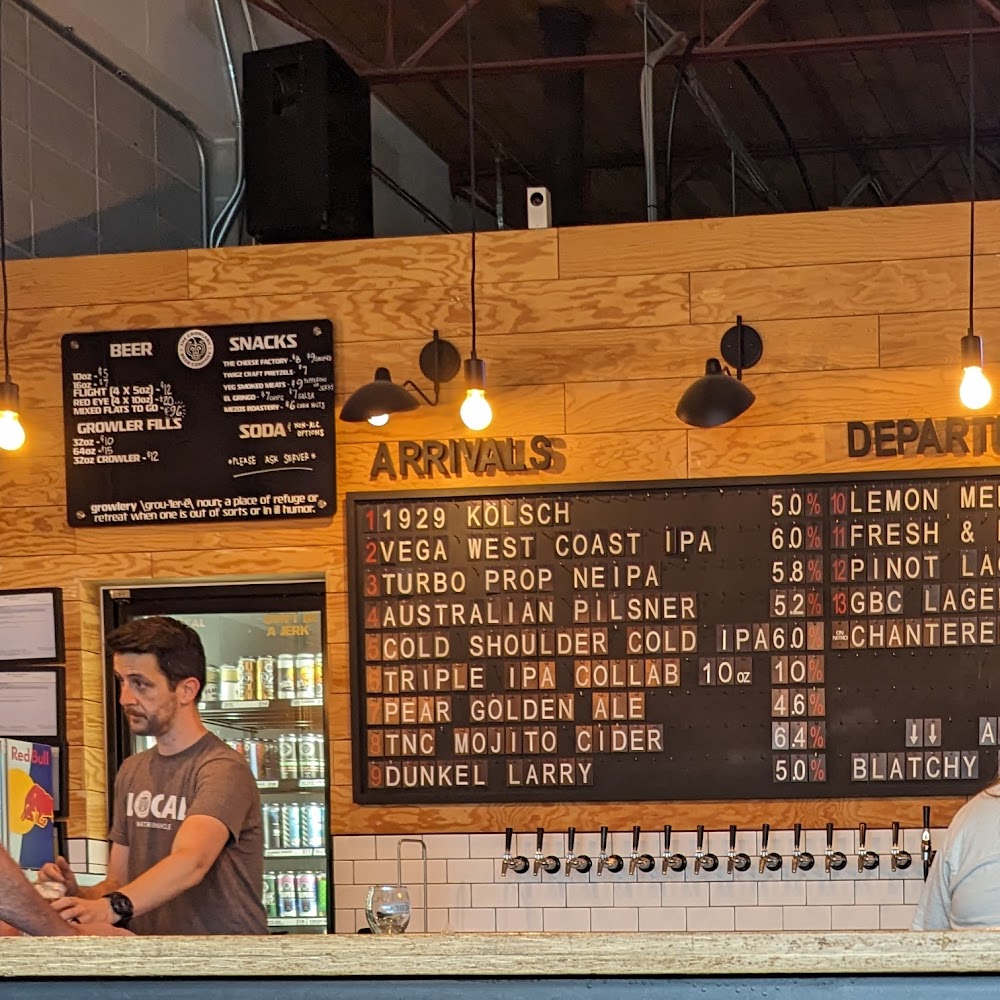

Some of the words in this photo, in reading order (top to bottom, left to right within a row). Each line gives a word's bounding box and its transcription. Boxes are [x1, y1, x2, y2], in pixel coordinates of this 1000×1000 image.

[110, 342, 153, 357] BEER
[229, 334, 298, 352] SNACKS
[260, 358, 288, 366] FACTORY
[73, 388, 107, 397] FLIGHT
[73, 398, 90, 406] RED
[93, 397, 109, 406] EYE
[73, 406, 101, 415] MIXED
[103, 405, 130, 414] FLATS
[131, 405, 143, 413] TO
[145, 404, 158, 412] GO
[77, 419, 144, 434] GROWLER
[147, 417, 182, 431] FILLS
[239, 423, 287, 439] SODA
[73, 438, 94, 447] 32oz
[73, 447, 96, 456] 64oz
[96, 453, 141, 464] CROWLER
[370, 435, 556, 480] ARRIVALS
[90, 501, 137, 514] growlery
[233, 496, 258, 507] place
[260, 494, 271, 505] of
[273, 494, 306, 505] refuge
[307, 494, 319, 502] or
[851, 487, 938, 513] LEMON
[94, 512, 128, 522] retreat
[131, 511, 157, 521] when
[159, 511, 177, 519] one
[190, 509, 207, 518] out
[209, 508, 220, 518] of
[222, 507, 248, 517] sorts
[250, 506, 261, 515] or
[383, 507, 446, 530] 1929
[467, 501, 570, 528] KÖLSCH
[851, 522, 939, 547] FRESH
[961, 520, 975, 544] &
[380, 539, 447, 562] VEGA
[468, 536, 534, 560] WEST
[555, 533, 641, 557] COAST
[665, 531, 712, 554] IPA
[851, 556, 938, 580] PINOT
[382, 571, 466, 595] TURBO
[485, 568, 552, 591] PROP
[573, 565, 659, 589] NEIPA
[383, 601, 554, 627] AUSTRALIAN
[574, 597, 696, 621] PILSNER
[851, 590, 902, 614] GBC
[280, 625, 309, 636] JERK
[383, 637, 450, 660] COLD
[469, 632, 607, 656] SHOULDER
[628, 630, 696, 655] COLD
[722, 628, 769, 651] IPA
[384, 668, 484, 692] TRIPLE
[509, 667, 555, 688] IPA
[575, 663, 678, 688] COLLAB
[385, 701, 451, 724] PEAR
[470, 698, 574, 721] GOLDEN
[594, 697, 643, 719] ALE
[386, 733, 434, 755] TNC
[454, 730, 557, 754] MOJITO
[577, 729, 662, 752] CIDER
[11, 746, 30, 763] Red
[32, 749, 50, 766] Bull
[386, 765, 485, 787] DUNKEL
[509, 763, 592, 785] LARRY
[853, 755, 977, 779] BLATCHY
[127, 790, 187, 820] LOCAL
